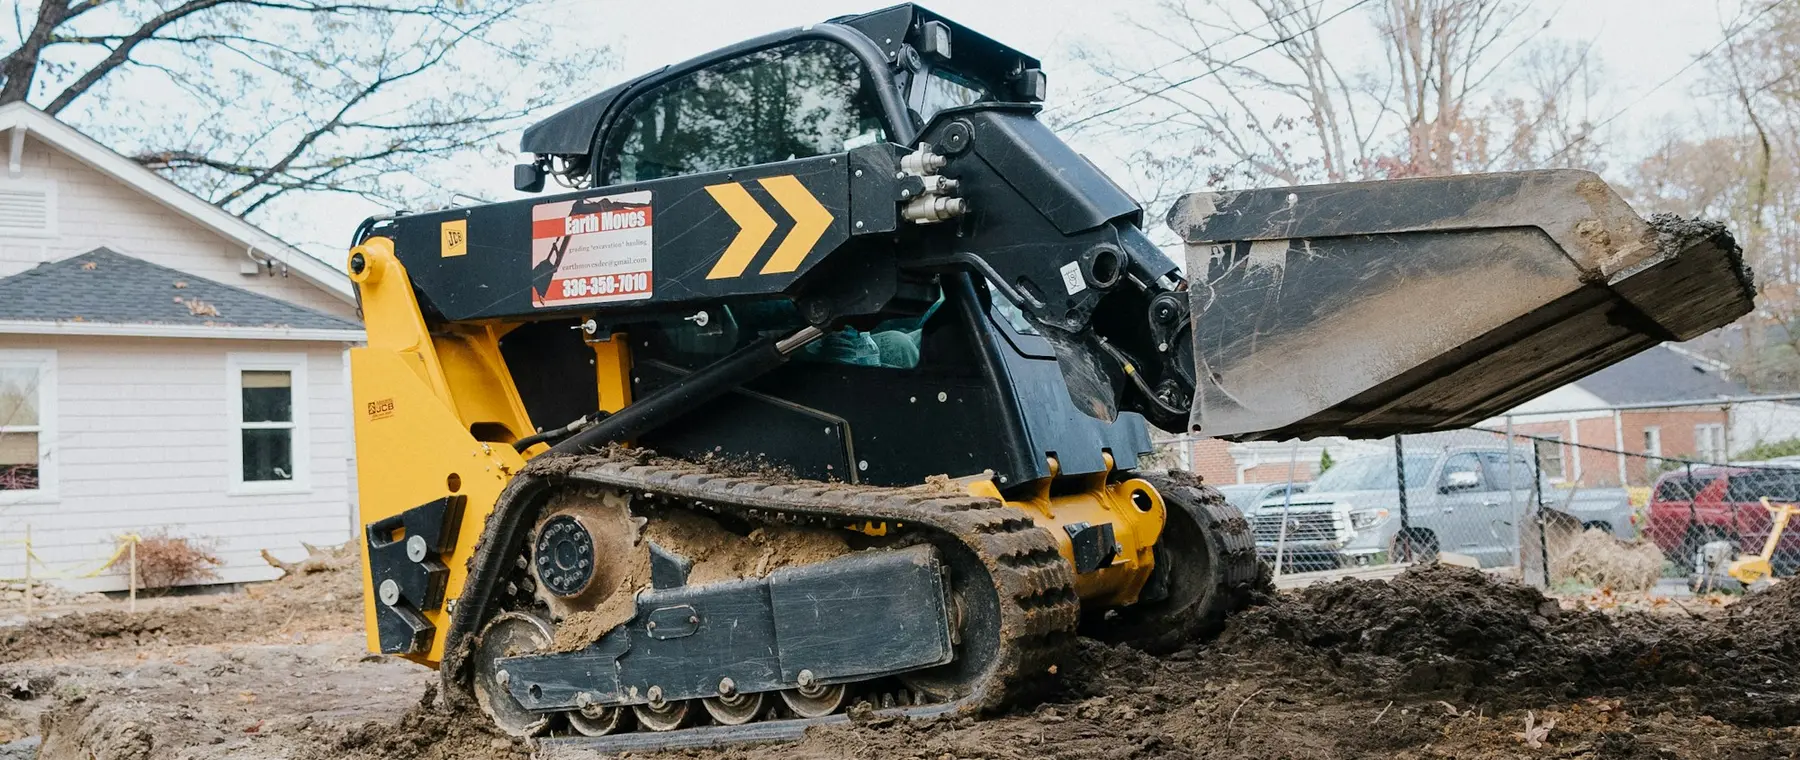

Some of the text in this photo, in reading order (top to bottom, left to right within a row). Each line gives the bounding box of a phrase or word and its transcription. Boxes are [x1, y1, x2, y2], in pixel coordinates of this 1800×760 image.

[565, 211, 645, 235] Earth Moves
[448, 231, 462, 247] JCB
[569, 245, 590, 253] grading
[563, 273, 647, 297] 336-358-7010
[376, 402, 394, 413] JCB
